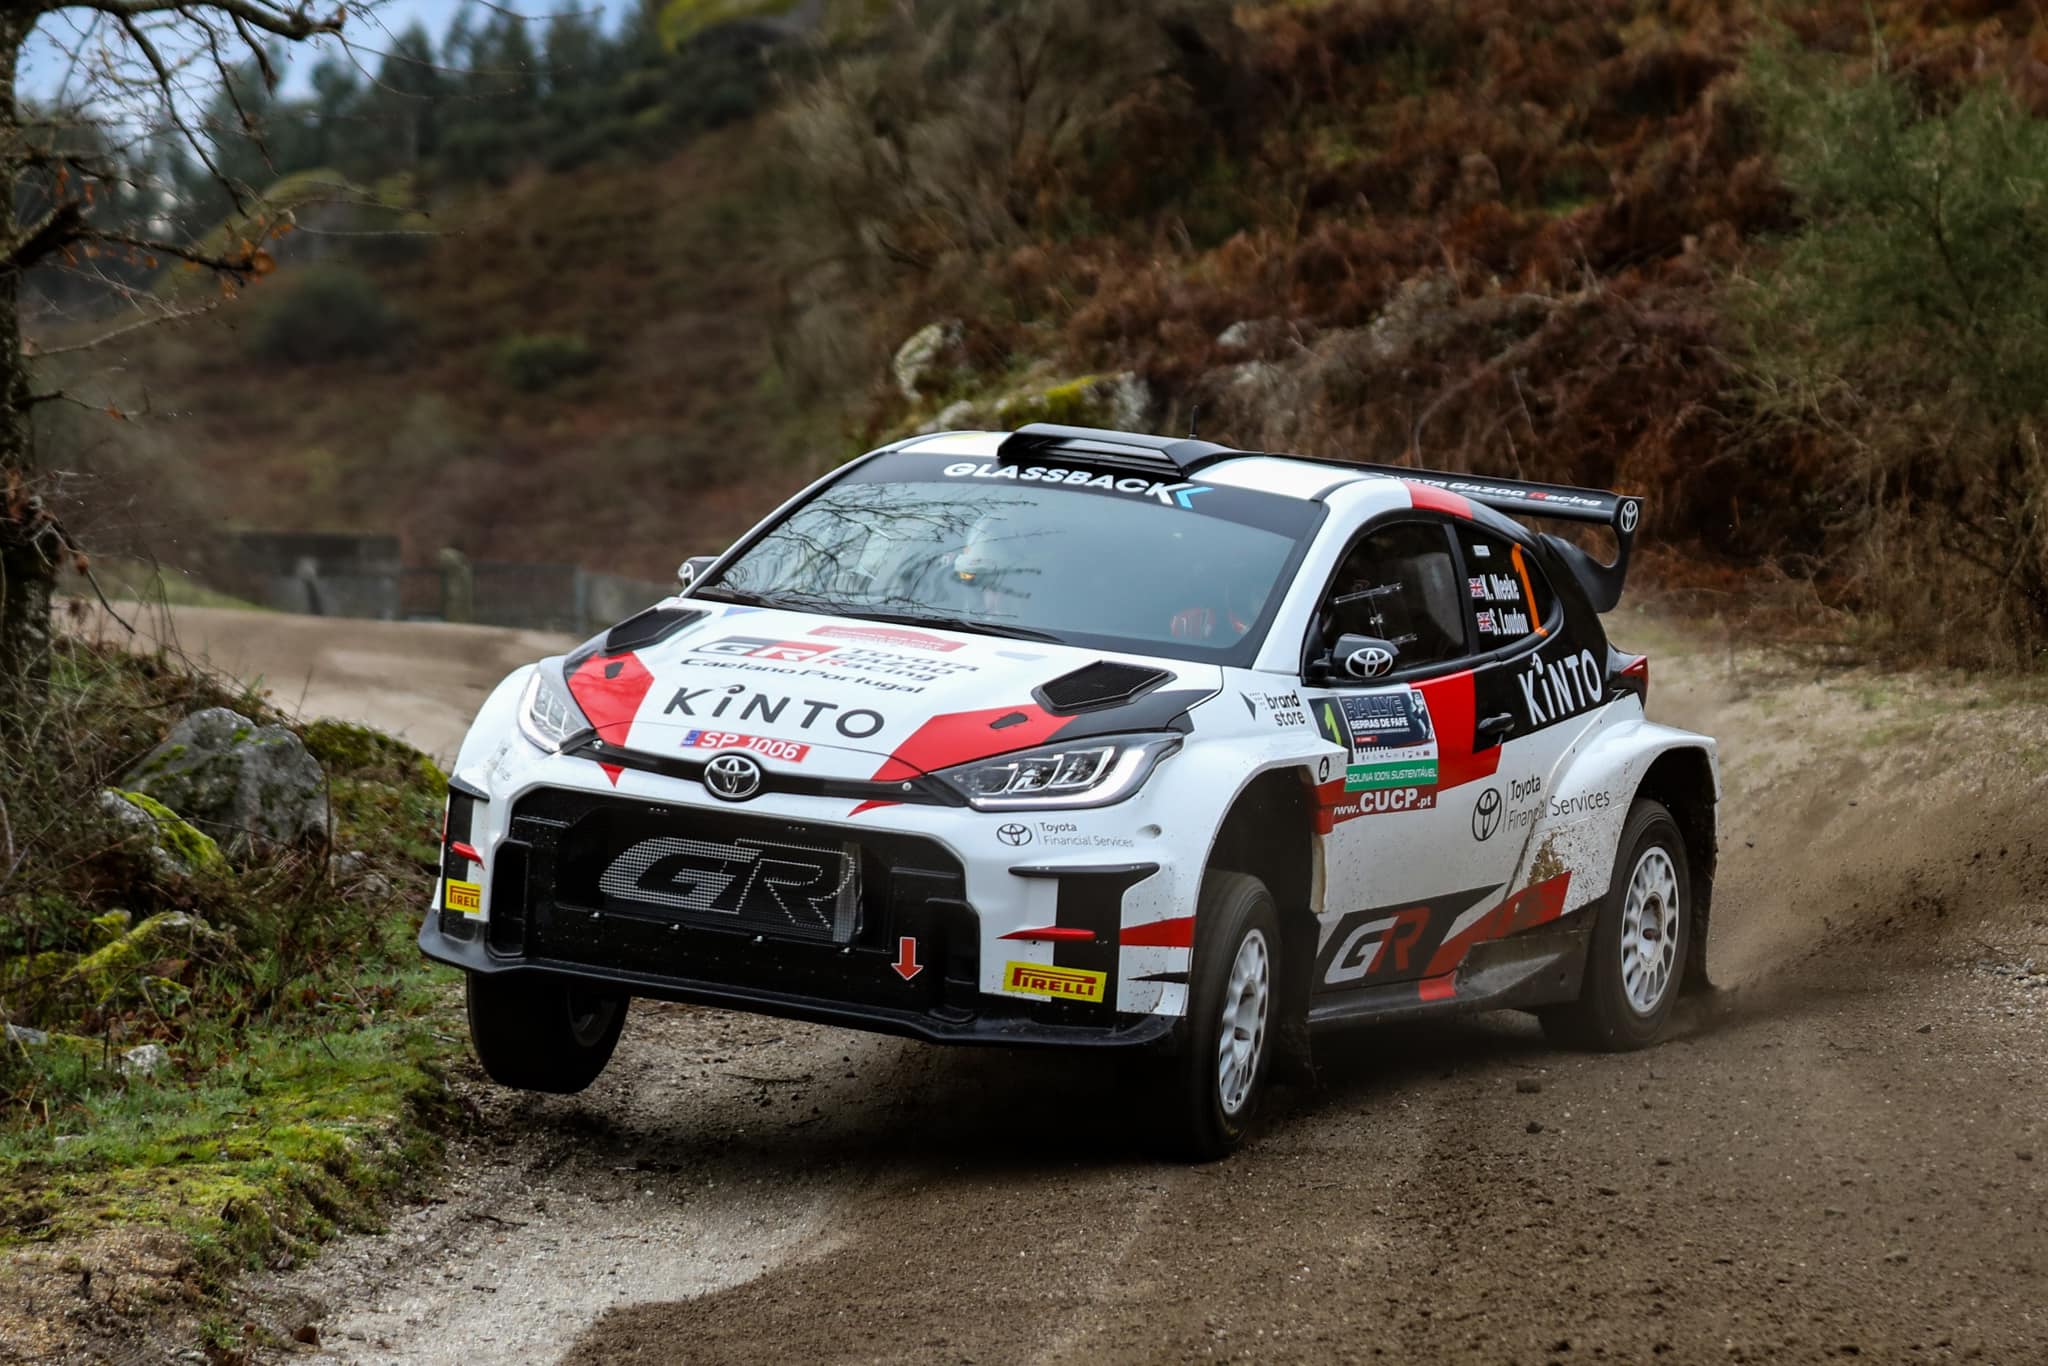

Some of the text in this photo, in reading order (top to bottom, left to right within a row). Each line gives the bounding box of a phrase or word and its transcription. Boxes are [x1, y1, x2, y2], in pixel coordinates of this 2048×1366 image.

[943, 463, 1195, 505] GLASSBACK
[1529, 491, 1602, 506] Racing
[816, 658, 938, 681] Racing
[831, 653, 955, 675] GAZOO
[852, 648, 980, 672] TOYOTA
[680, 658, 926, 694] Caetano Portugal
[1263, 689, 1301, 710] brand
[1341, 695, 1406, 719] RALLYE
[1274, 711, 1306, 727] store
[1350, 717, 1408, 729] SERRAS DE FAFE
[700, 732, 801, 760] SP 1006
[1511, 775, 1541, 803] Toyota
[1551, 790, 1610, 817] Services
[1039, 822, 1078, 834] Toyota
[1043, 835, 1134, 848] Financial Services
[598, 837, 856, 931] GR
[1324, 905, 1431, 984] GR
[1012, 967, 1097, 997] PIRELLI
